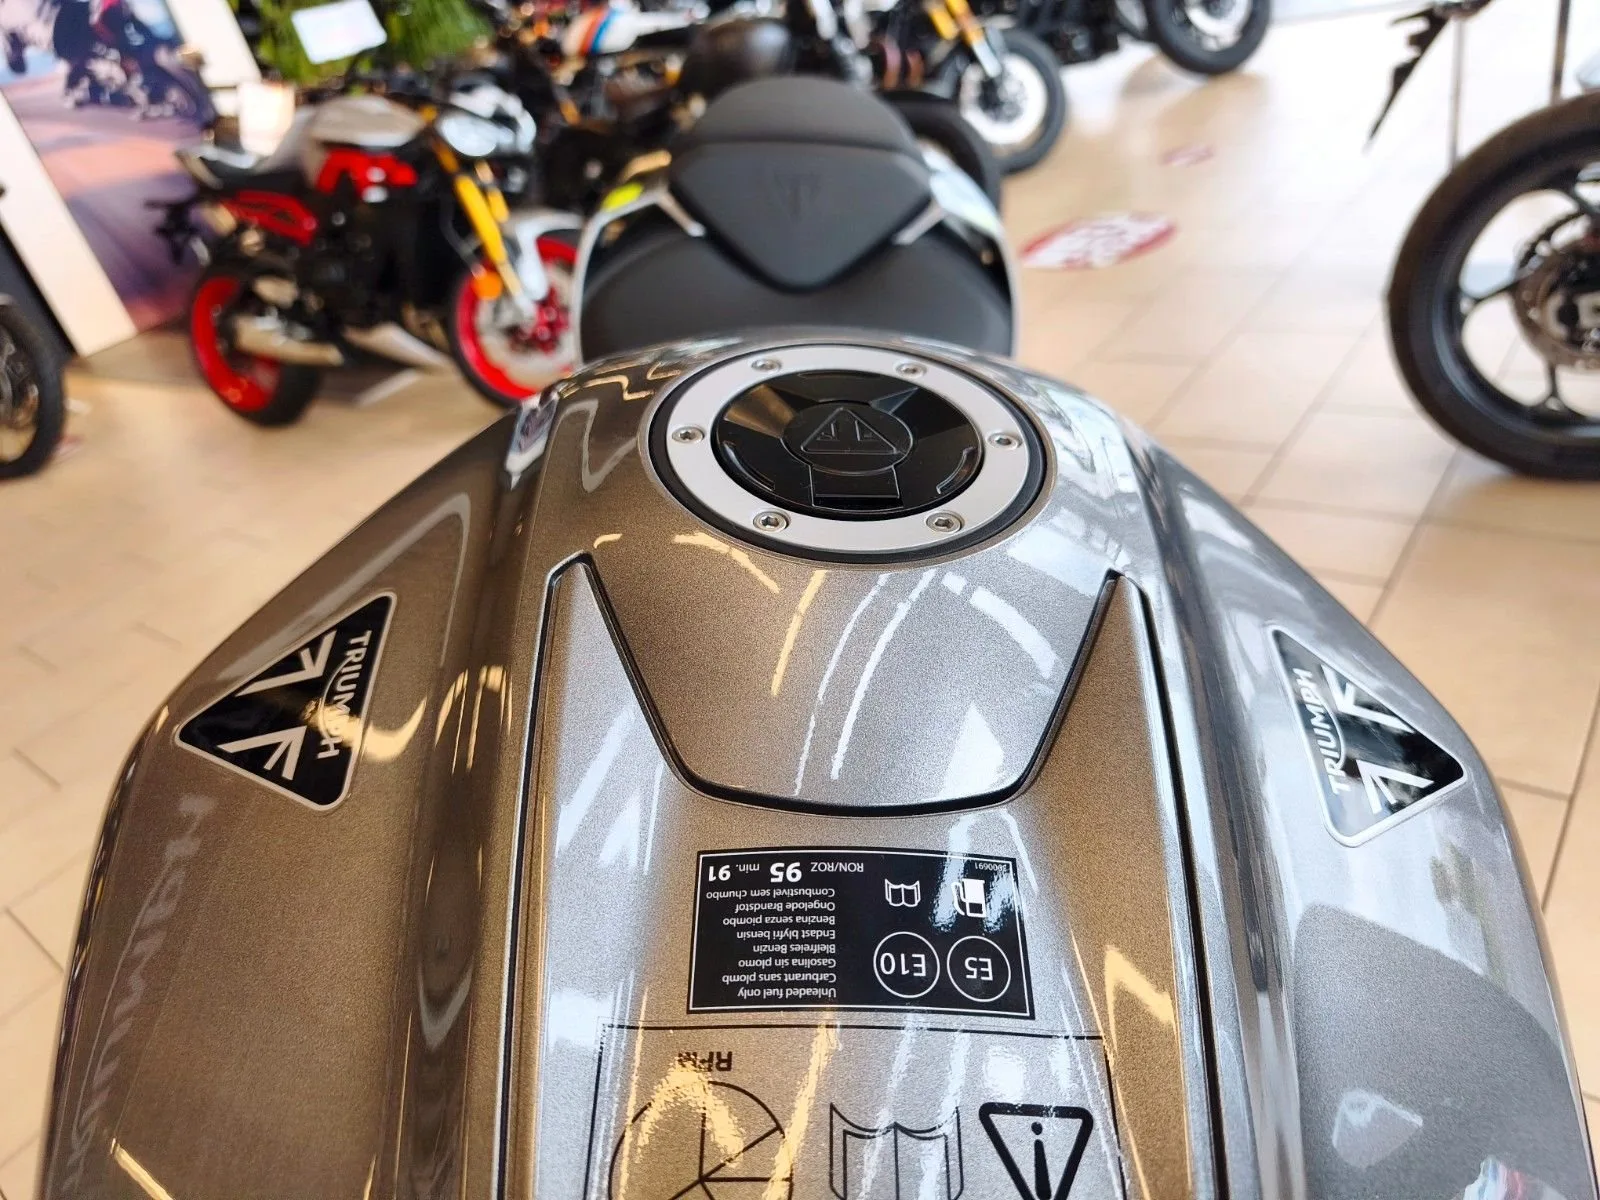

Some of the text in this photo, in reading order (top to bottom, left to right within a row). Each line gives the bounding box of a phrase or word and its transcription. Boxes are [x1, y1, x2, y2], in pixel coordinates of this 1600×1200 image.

[317, 630, 372, 759] TRIUMH
[1292, 667, 1352, 795] TRIUMPH
[708, 862, 864, 882] RON/ROZ 95 min. 91
[706, 890, 747, 900] chumbo
[773, 888, 835, 898] Combustivel
[735, 900, 835, 913] Ongelode Brandstof
[723, 915, 835, 927] Benzina senza piombo
[737, 928, 835, 940] Endast blyfri bensin
[753, 944, 835, 954] Bleifreies Benzin
[738, 957, 836, 969] Gasolina sin plomo
[880, 952, 926, 976] E10
[964, 957, 993, 981] E5
[722, 972, 836, 985] Carburant sans plomb
[738, 987, 836, 999] Unleaded fuel only
